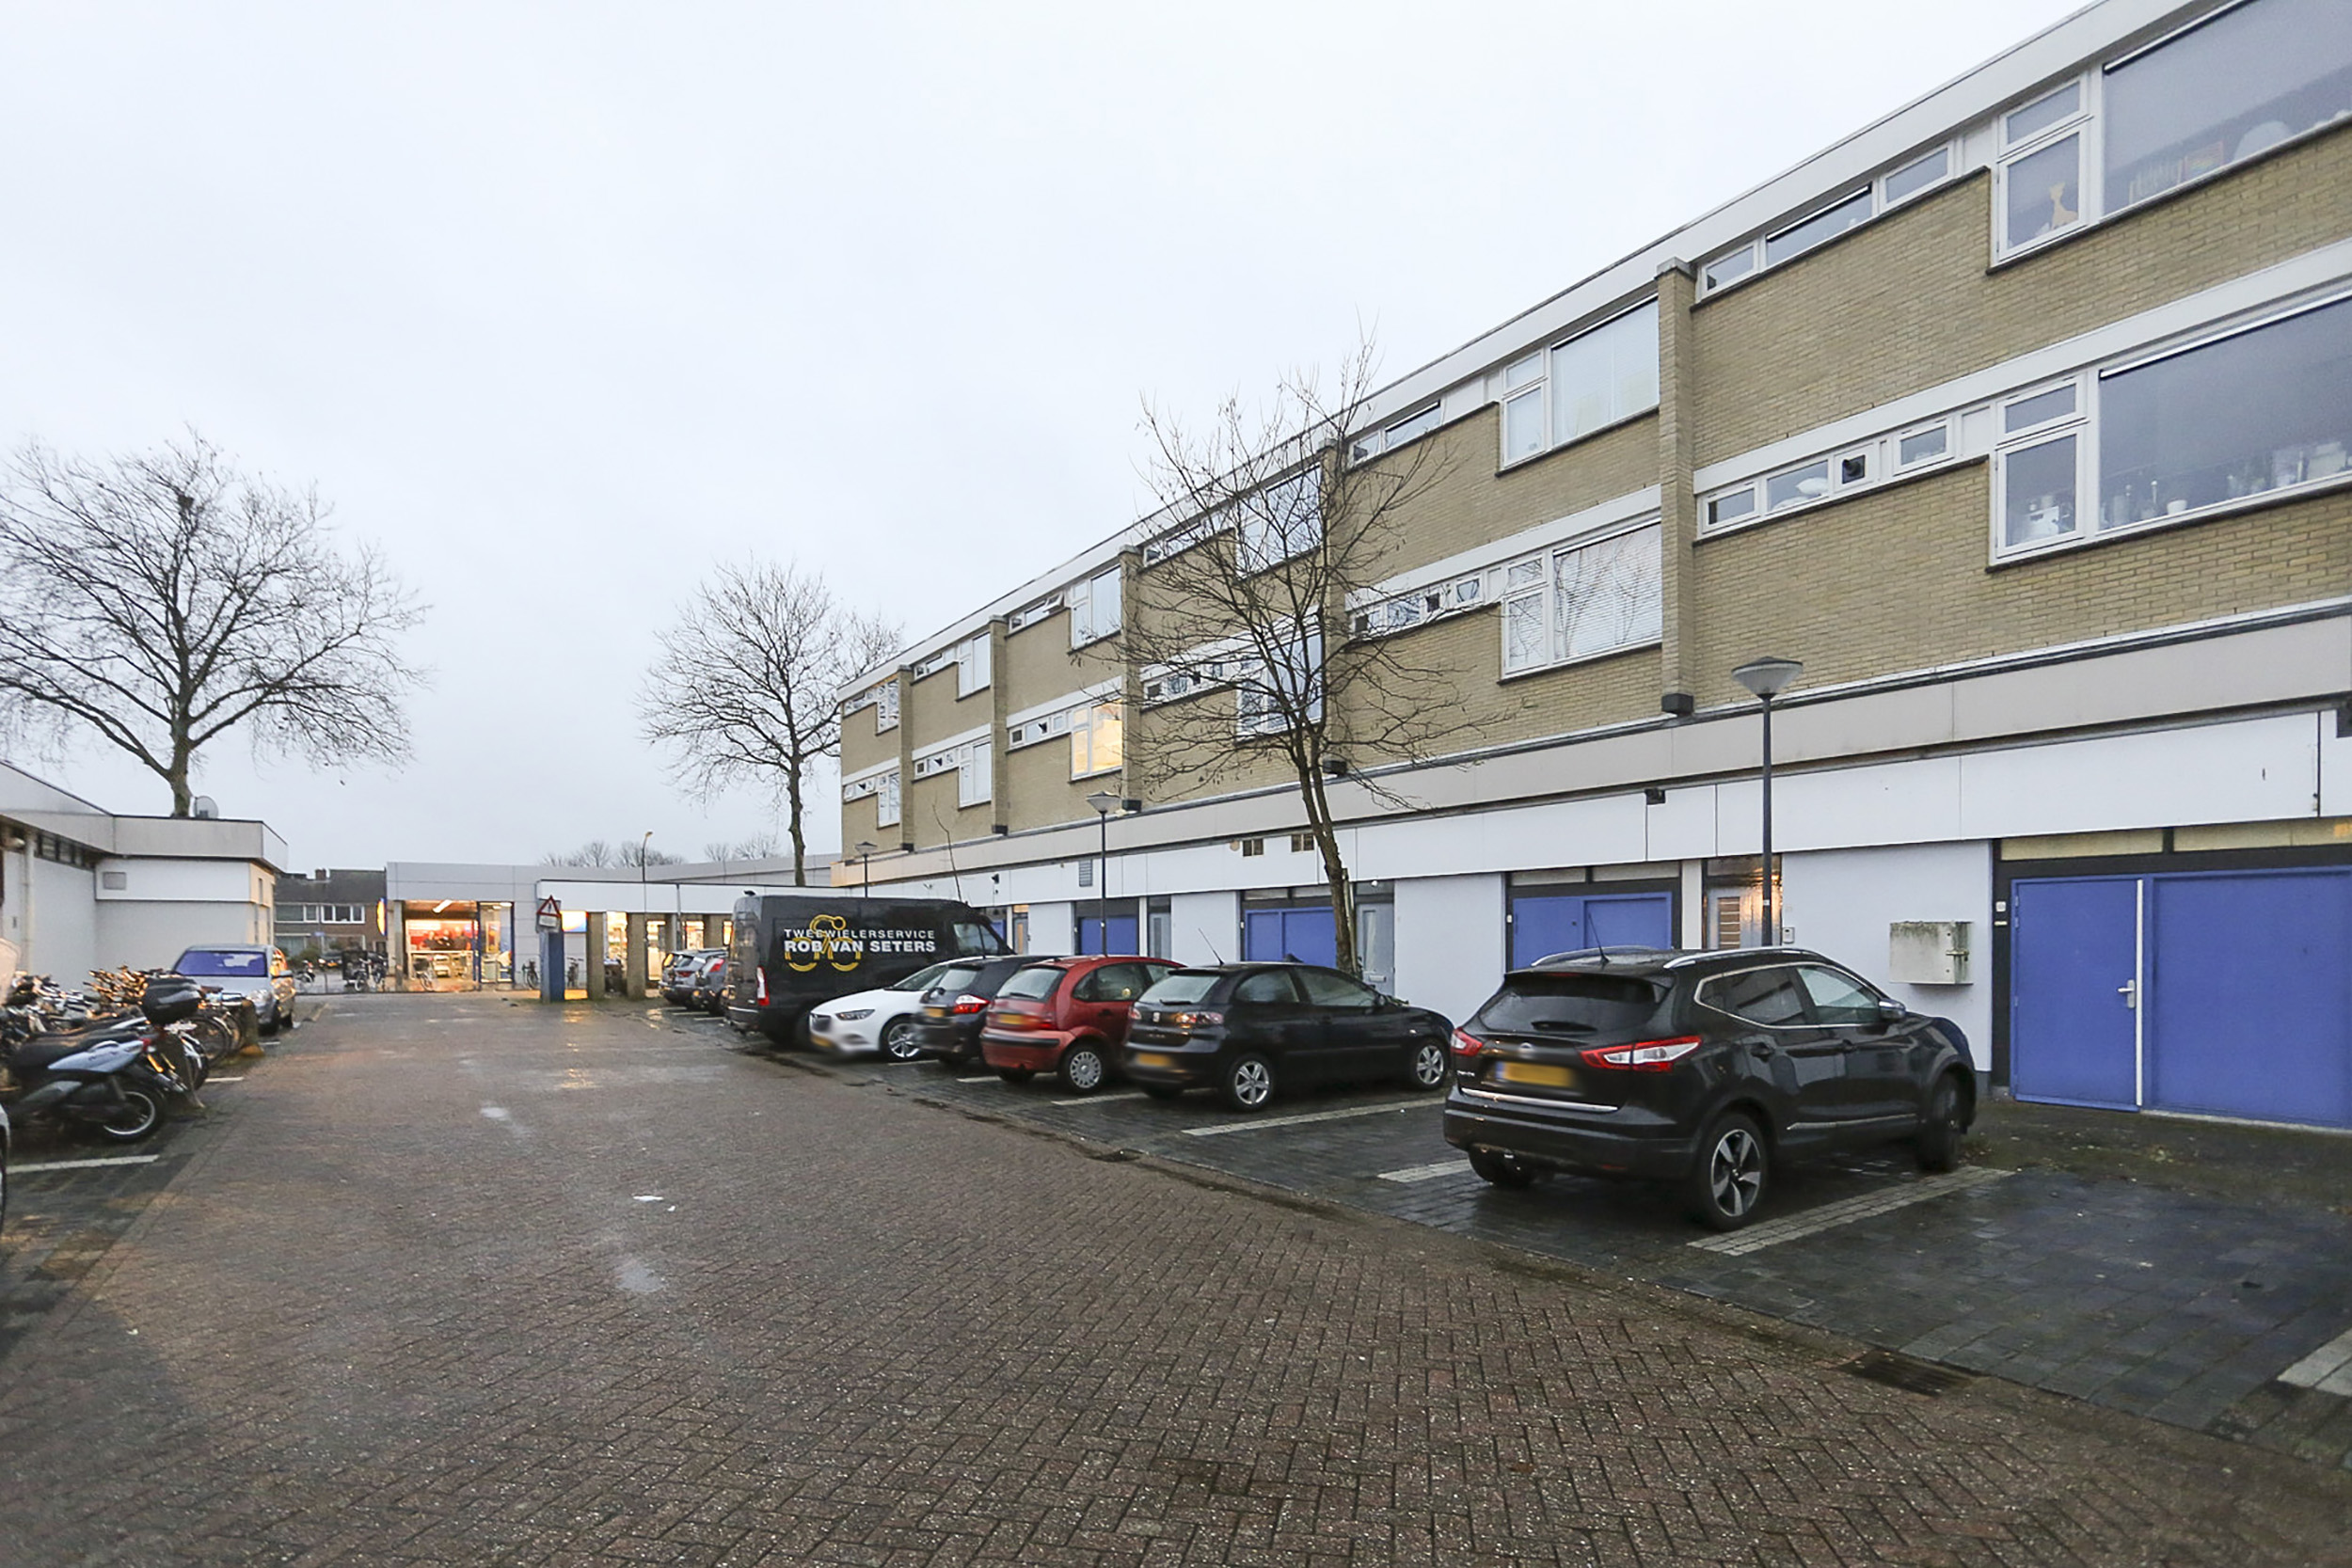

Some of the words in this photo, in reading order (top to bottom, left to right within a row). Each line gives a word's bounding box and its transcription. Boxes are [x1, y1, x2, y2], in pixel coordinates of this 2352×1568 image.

[784, 928, 935, 940] TWEEWIELERSERVICE
[784, 941, 823, 953] ROB
[829, 941, 864, 953] VAN
[869, 941, 936, 953] SETERS
